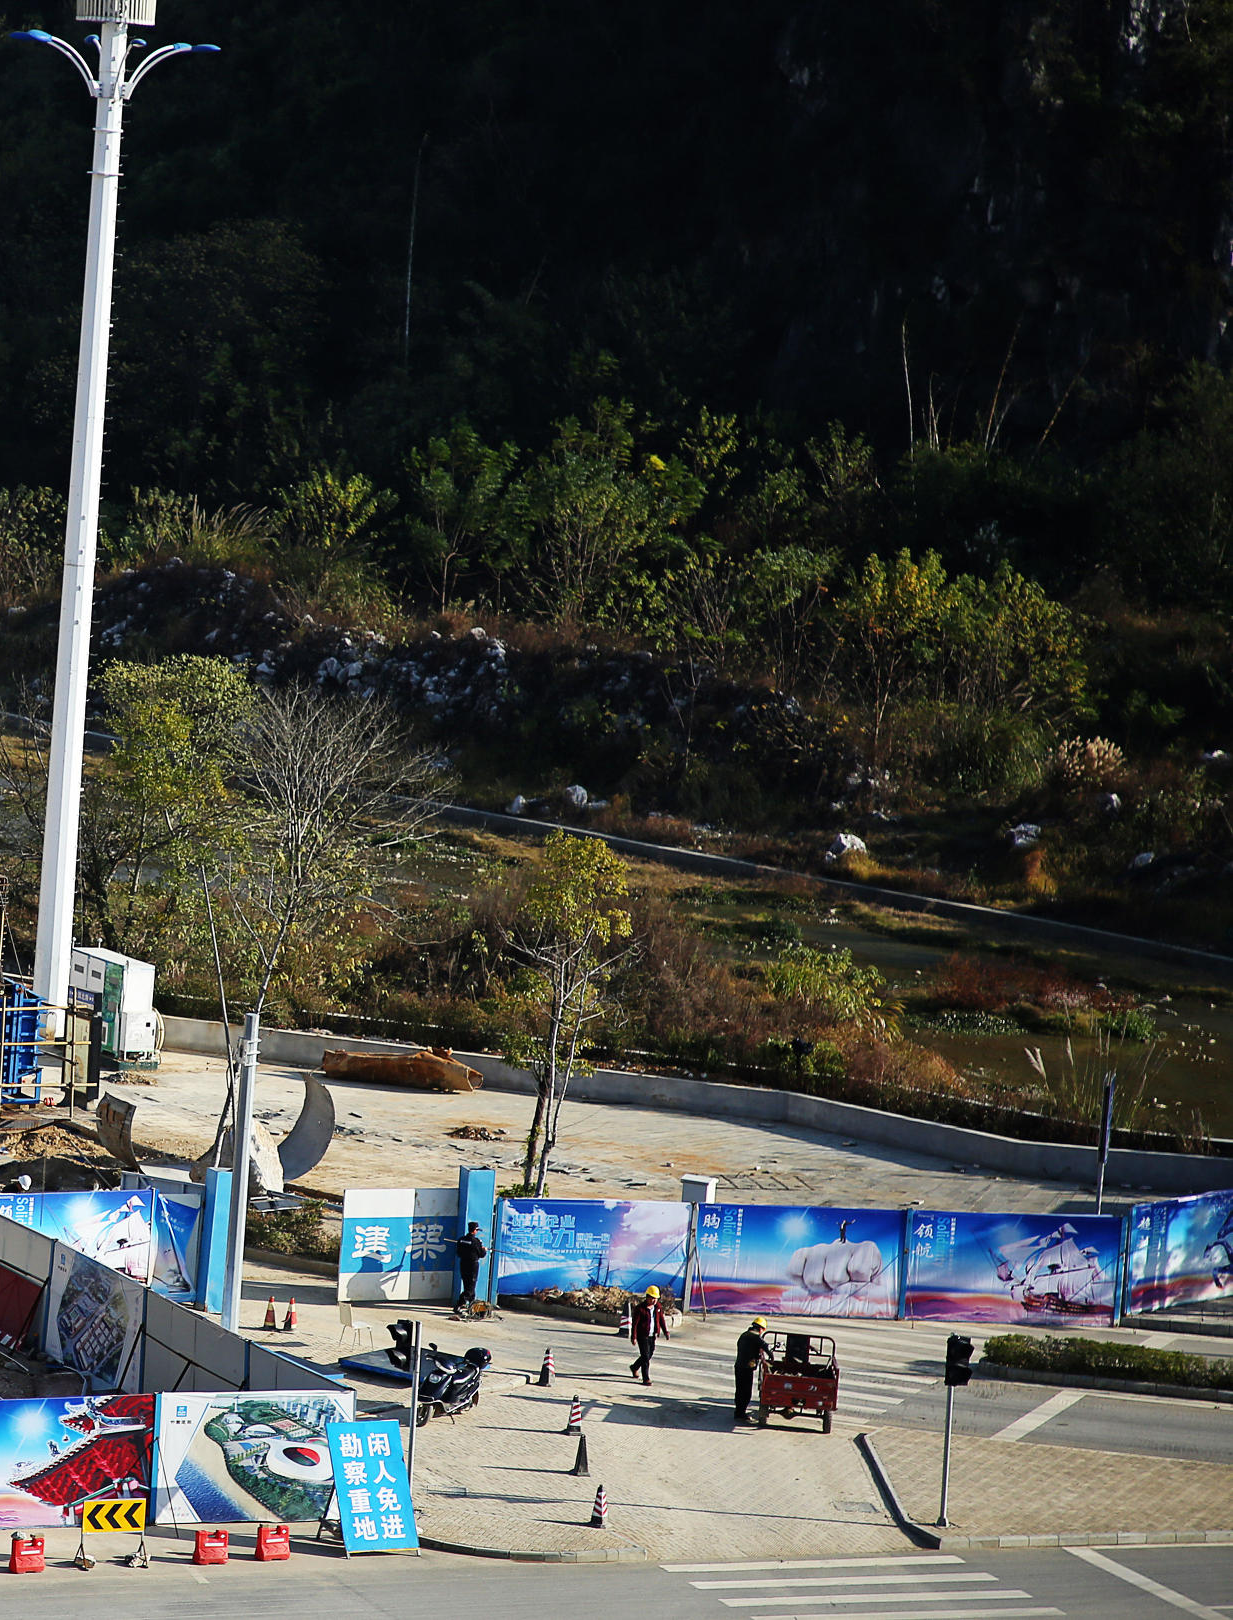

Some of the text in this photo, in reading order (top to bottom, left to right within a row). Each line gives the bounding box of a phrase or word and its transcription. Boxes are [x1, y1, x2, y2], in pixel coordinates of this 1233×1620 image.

[700, 1213, 721, 1249] 胸襟
[913, 1223, 934, 1259] 领航
[338, 1432, 379, 1541] 勘察重地
[367, 1432, 407, 1540] 闲人免进
